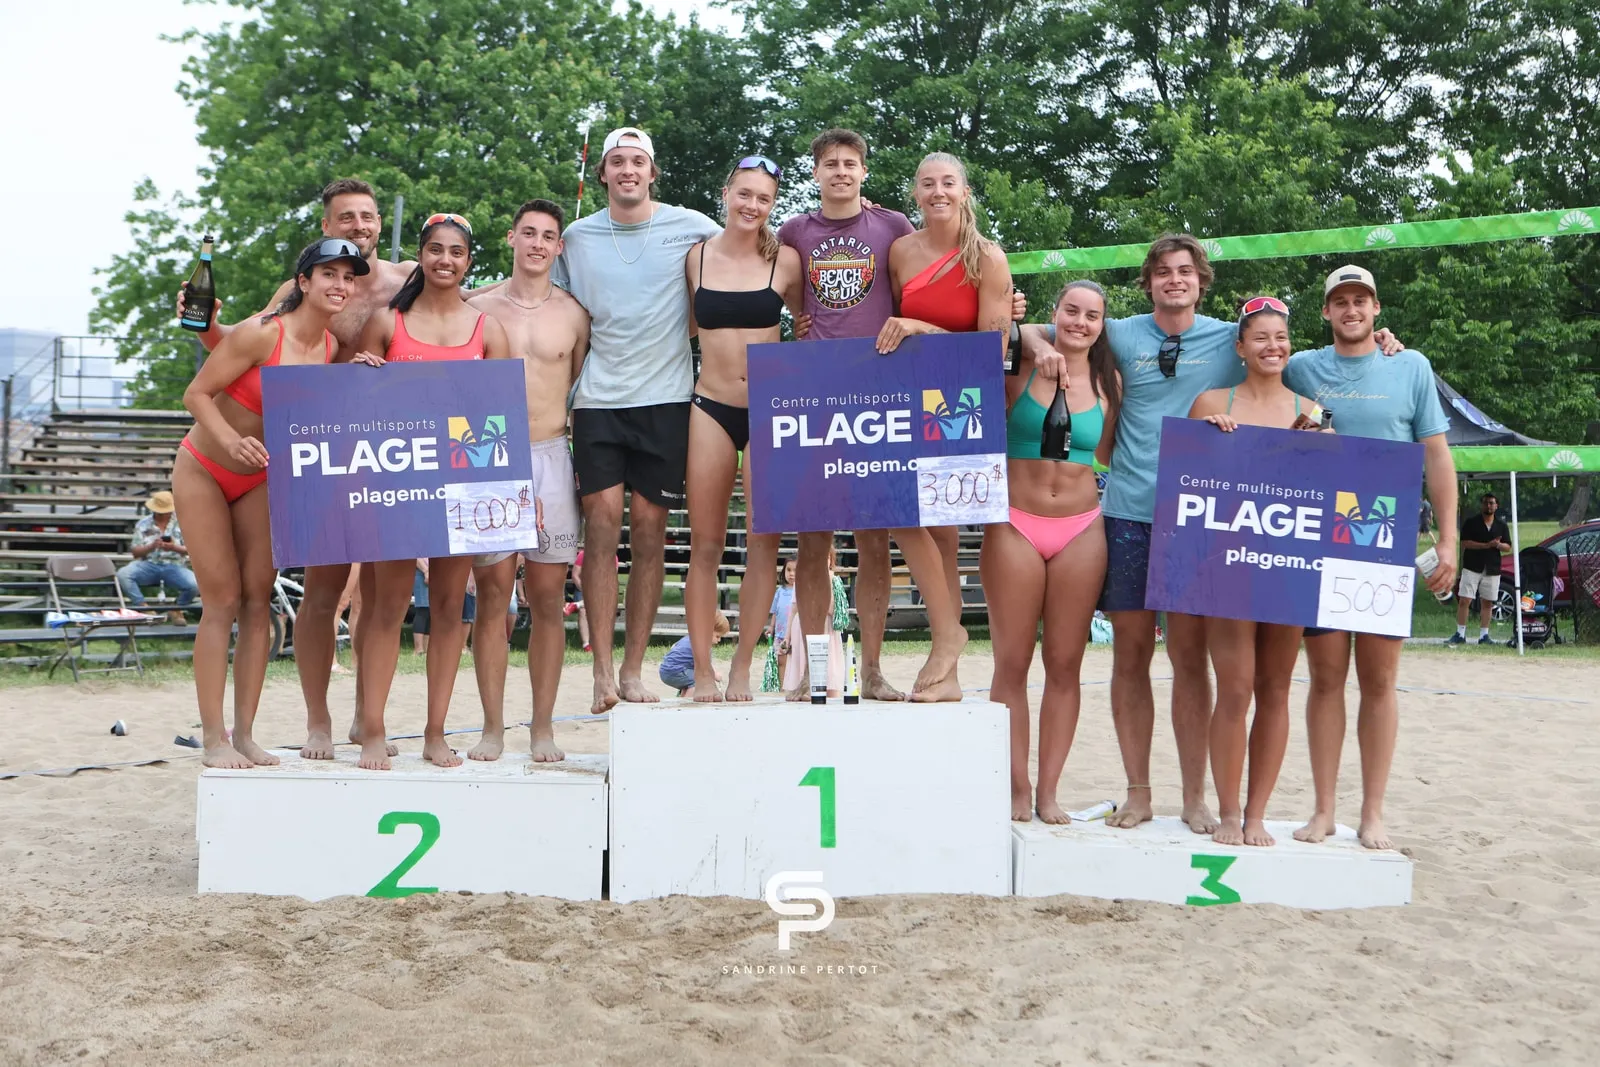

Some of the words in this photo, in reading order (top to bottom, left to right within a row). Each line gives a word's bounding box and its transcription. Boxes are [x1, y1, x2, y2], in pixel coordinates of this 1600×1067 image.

[811, 236, 871, 257] ONTARIO
[819, 268, 862, 287] BEACH
[818, 279, 863, 300] TOUR
[771, 397, 819, 409] Centre
[826, 392, 911, 407] multisports
[289, 422, 341, 436] Centre
[349, 418, 436, 434] multisports
[771, 409, 912, 449] PLAGE
[290, 436, 439, 477] PLAGE
[823, 458, 918, 478] plagem.c
[348, 486, 446, 508] plagem.c
[1179, 474, 1231, 491] Centre
[1236, 482, 1324, 501] multisports
[1176, 493, 1323, 541] PLAGE
[554, 533, 575, 542] POLY
[1225, 546, 1323, 571] plagem.c
[798, 766, 836, 848] 1
[365, 811, 441, 898] 2
[1186, 854, 1241, 906] 3
